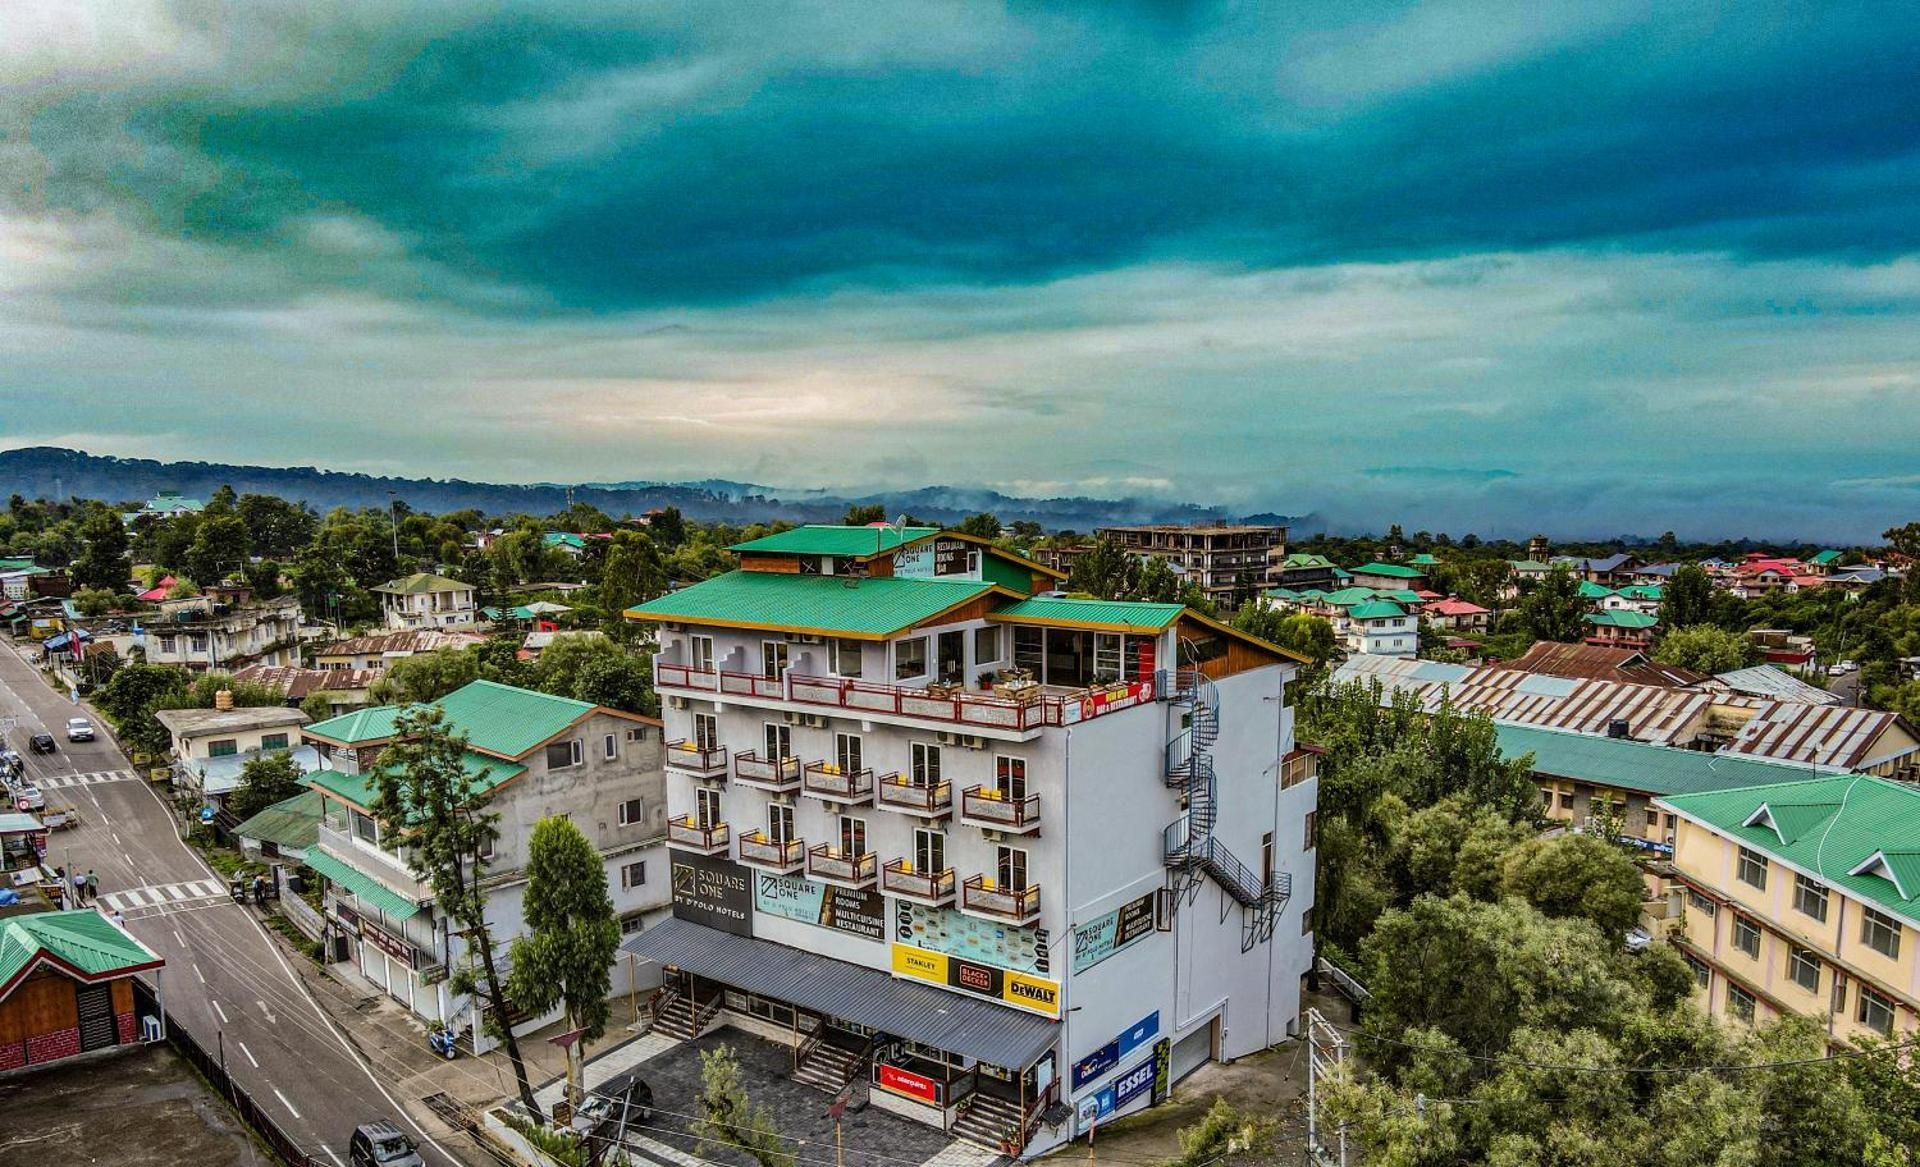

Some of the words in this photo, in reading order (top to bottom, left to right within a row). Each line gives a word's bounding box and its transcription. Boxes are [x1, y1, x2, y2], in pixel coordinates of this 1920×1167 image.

[905, 544, 933, 555] SQUARE
[906, 555, 920, 563] ONE
[699, 869, 745, 891] SQUARE
[779, 878, 817, 895] SQUARE
[700, 883, 723, 899] ONE
[780, 888, 799, 901] ONE
[835, 887, 868, 901] PREMIUM
[675, 895, 684, 903] BY
[716, 906, 745, 920] HOTELS
[835, 896, 861, 910] ROOMS
[835, 908, 885, 928] MULTICUISINE
[835, 918, 880, 937] RESTAURANT
[1088, 917, 1114, 936] SQUARE
[1088, 931, 1102, 943] ONE
[906, 957, 936, 970] STANLEY
[962, 975, 988, 987] DECKER
[1118, 1064, 1154, 1098] ESSEL
